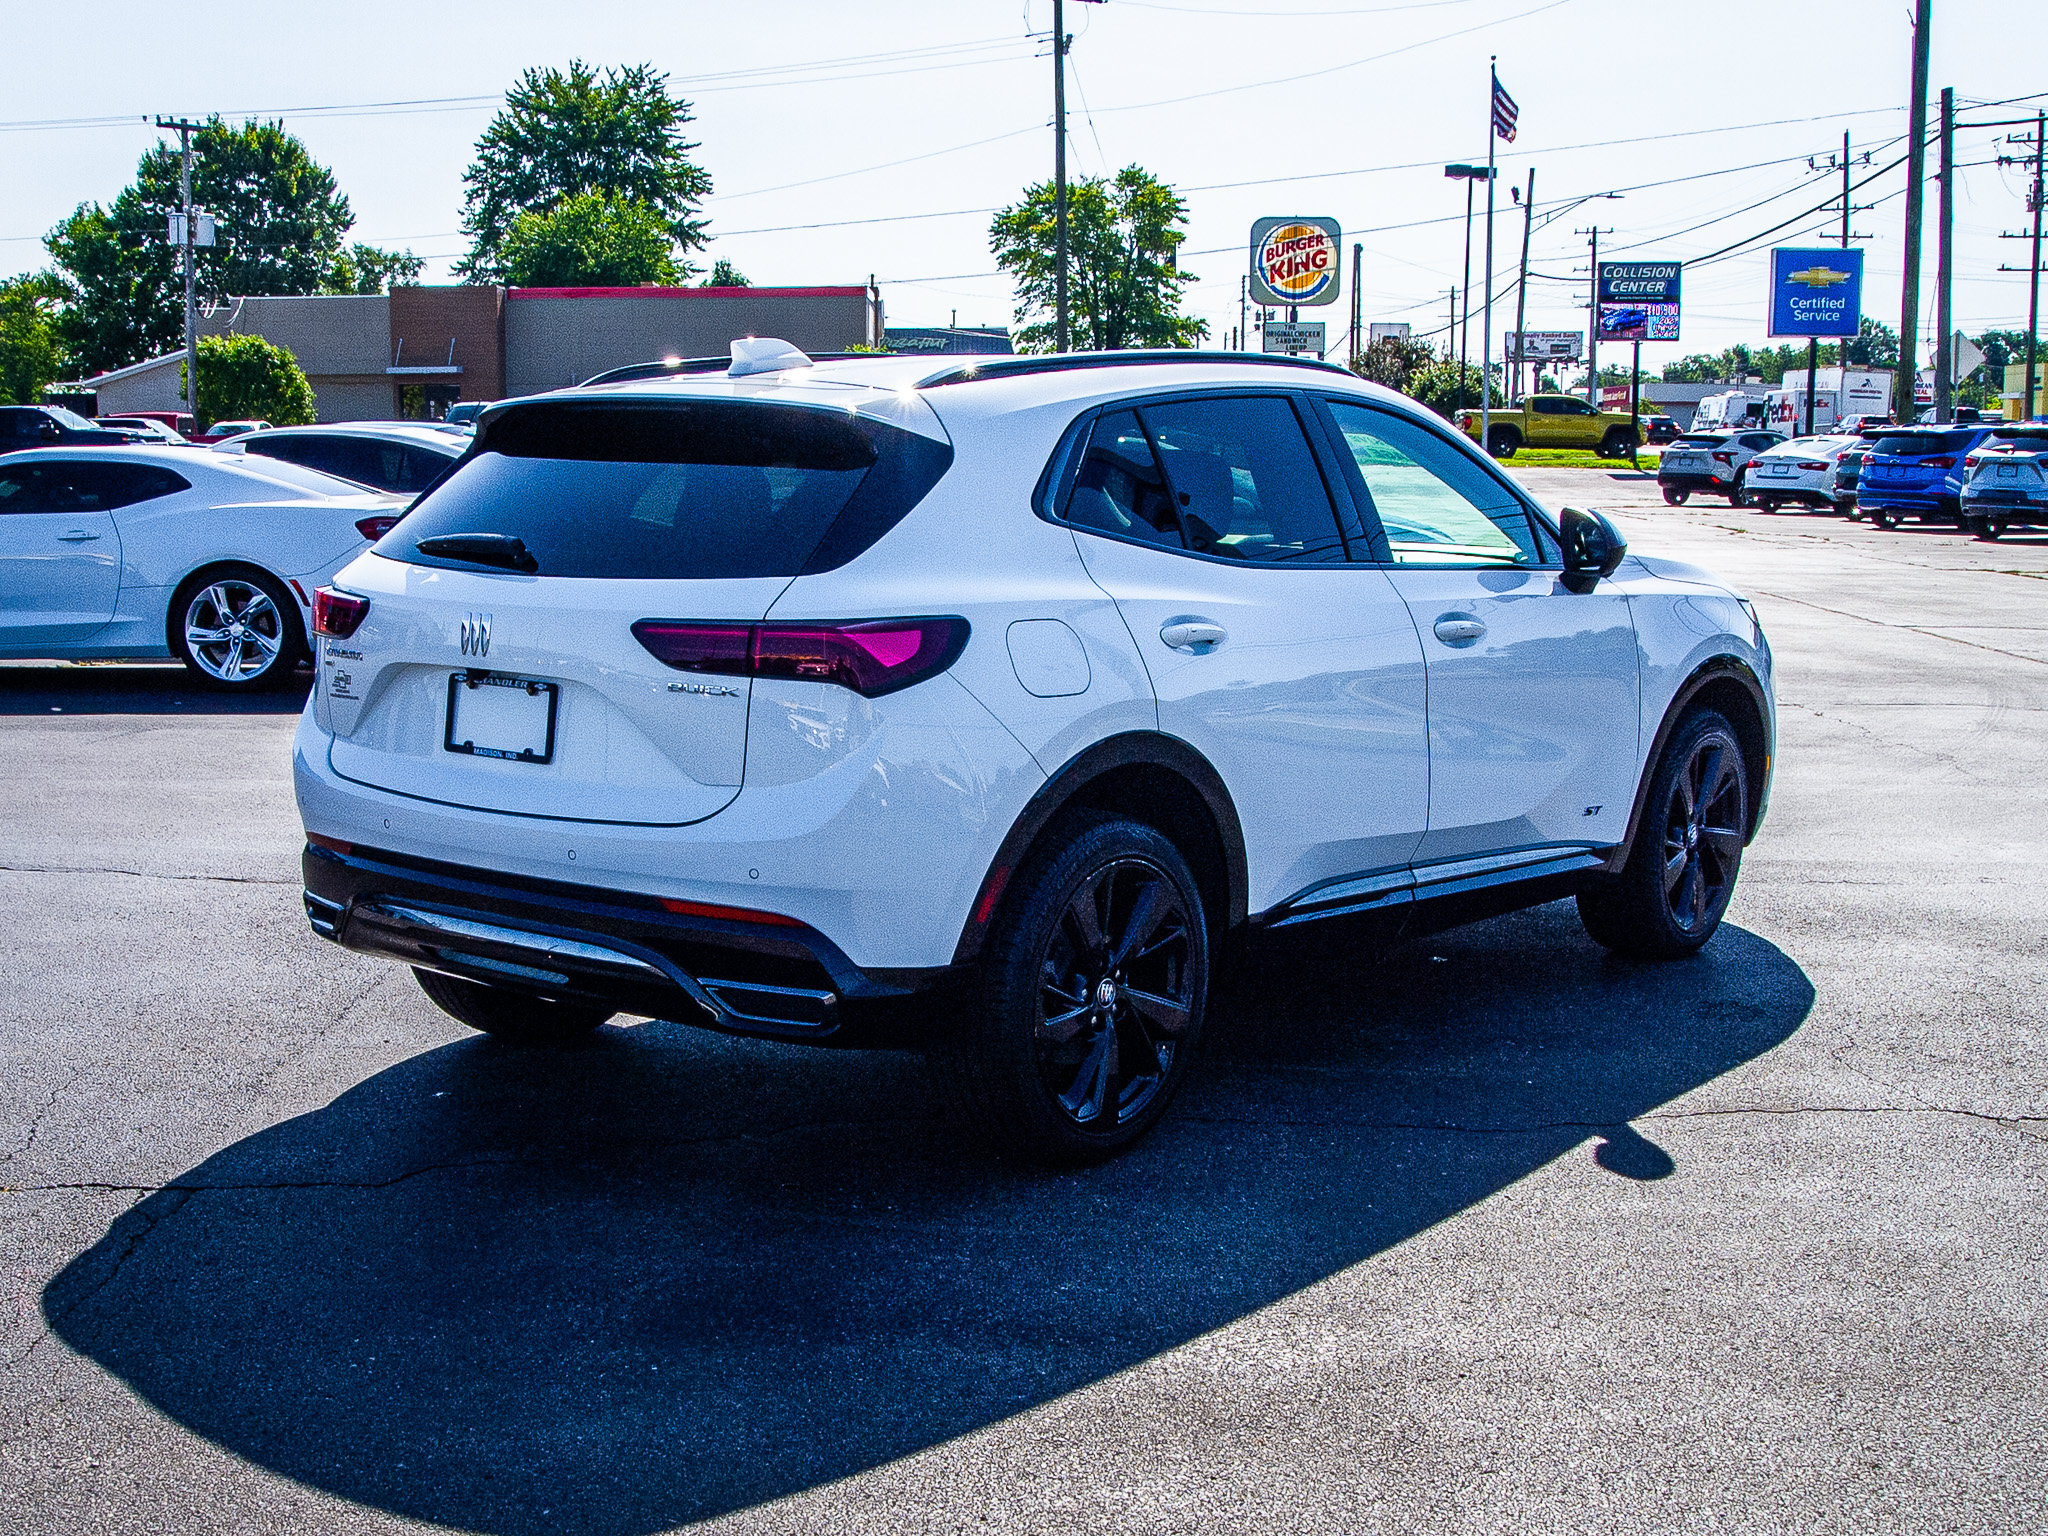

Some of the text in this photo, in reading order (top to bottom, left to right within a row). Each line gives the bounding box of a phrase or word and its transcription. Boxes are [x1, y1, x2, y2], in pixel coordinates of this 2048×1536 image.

[1266, 234, 1324, 262] BURGER
[1269, 250, 1328, 283] KING
[1603, 266, 1676, 278] COLLISION
[1609, 281, 1666, 292] CENTER
[1790, 297, 1845, 308] Certified
[1793, 310, 1840, 321] Service
[667, 682, 739, 697] BUICK
[1582, 804, 1603, 816] ST
